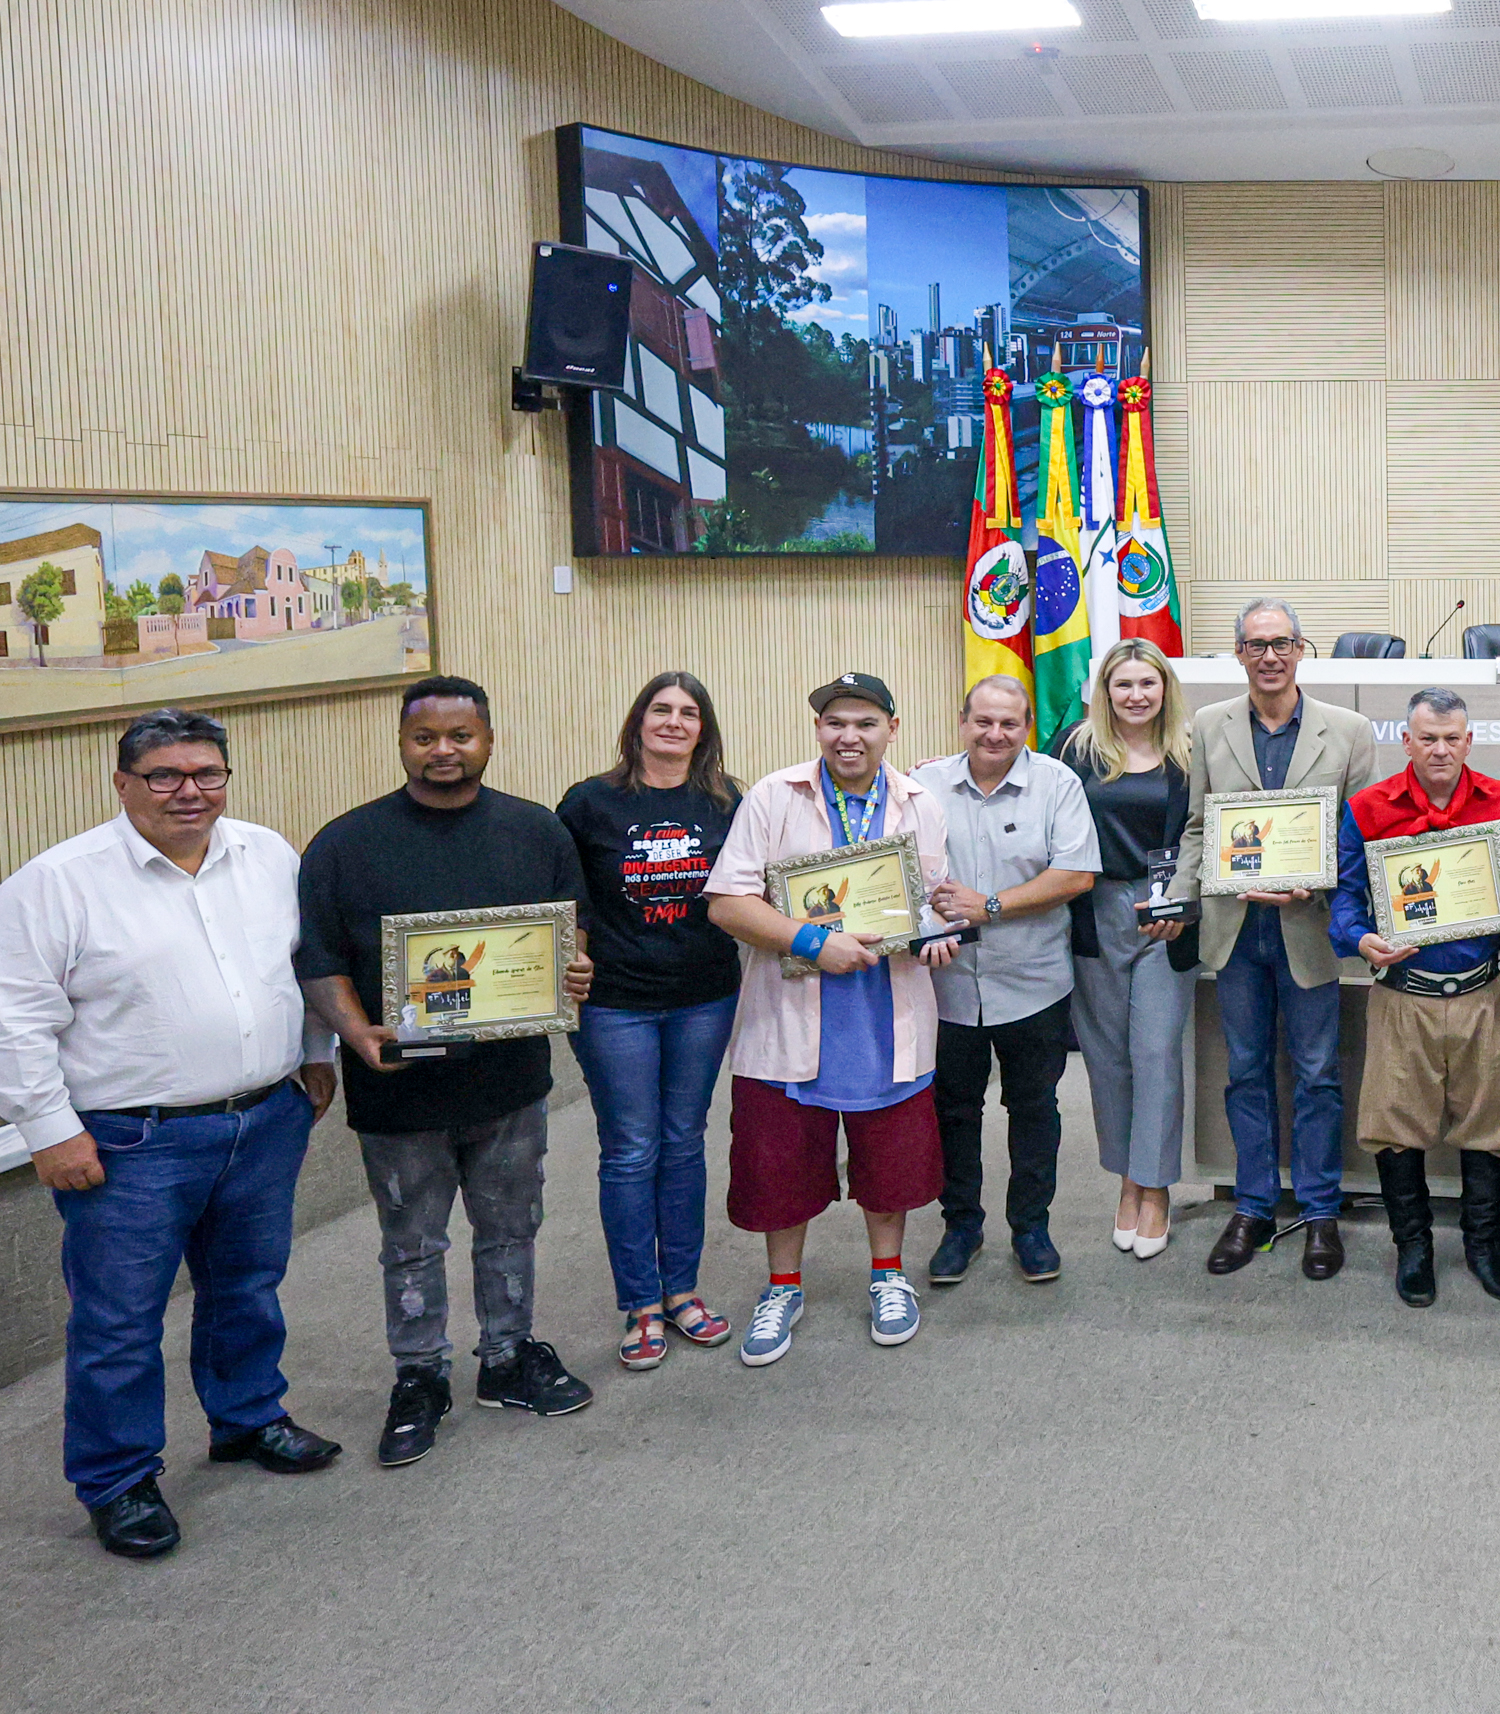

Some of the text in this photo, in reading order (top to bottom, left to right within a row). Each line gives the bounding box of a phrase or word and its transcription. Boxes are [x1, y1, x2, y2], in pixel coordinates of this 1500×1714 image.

[1060, 330, 1117, 339] 124 Norte
[633, 835, 701, 851] sagrado
[653, 848, 682, 860] DE SER
[625, 870, 709, 883] nós o cometeremos
[627, 879, 705, 897] SEMPRE
